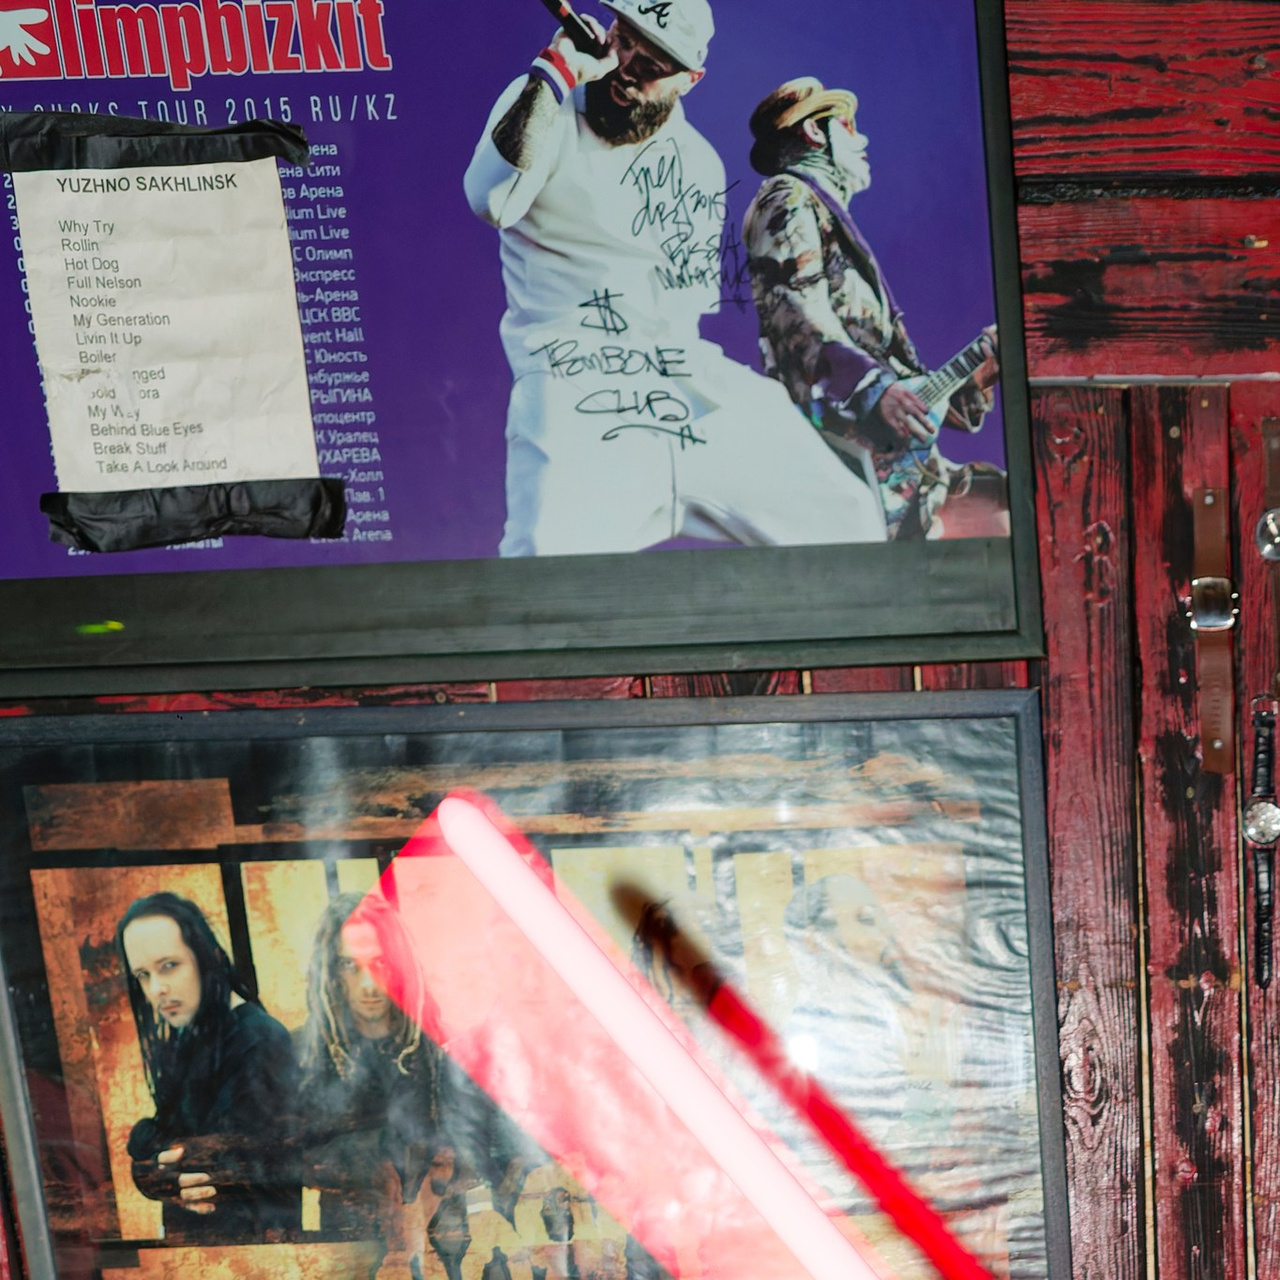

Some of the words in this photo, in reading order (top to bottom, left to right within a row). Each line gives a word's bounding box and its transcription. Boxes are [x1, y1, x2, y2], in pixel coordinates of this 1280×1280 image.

[137, 99, 207, 125] TOUR
[225, 97, 292, 124] 2015
[310, 93, 398, 122] RU/KZ
[56, 176, 131, 193] YUZHNO
[136, 173, 238, 192] SAKHLINSK
[300, 183, 344, 201] Арена
[316, 204, 347, 219] Live
[58, 220, 89, 236] Why
[93, 220, 115, 236] Try
[319, 225, 350, 240] Live
[61, 238, 100, 252] Rollin
[305, 246, 354, 262] Олимп
[64, 258, 89, 271] Hot
[92, 257, 119, 273] Dog
[67, 277, 91, 289] Full
[95, 276, 142, 289] Nelson
[70, 295, 117, 308] Nookie
[297, 287, 359, 305] ь-Арена
[73, 313, 92, 328] My
[96, 312, 171, 326] Generation
[76, 332, 106, 345] Livin
[110, 332, 119, 344] It
[123, 332, 142, 347] Up
[335, 327, 365, 342] Hall
[79, 350, 117, 364] Boiler
[308, 368, 370, 386] нбуржье
[91, 387, 116, 400] old
[311, 387, 373, 404] РЫГИНА
[88, 404, 107, 420] My
[90, 423, 137, 436] Behind
[140, 422, 170, 436] Blue
[172, 421, 204, 438] Eyes
[93, 441, 132, 455] Break
[136, 441, 168, 455] Stuff
[96, 460, 129, 474] Take
[133, 460, 144, 473] A
[147, 460, 179, 474] Look
[182, 457, 228, 472] Around
